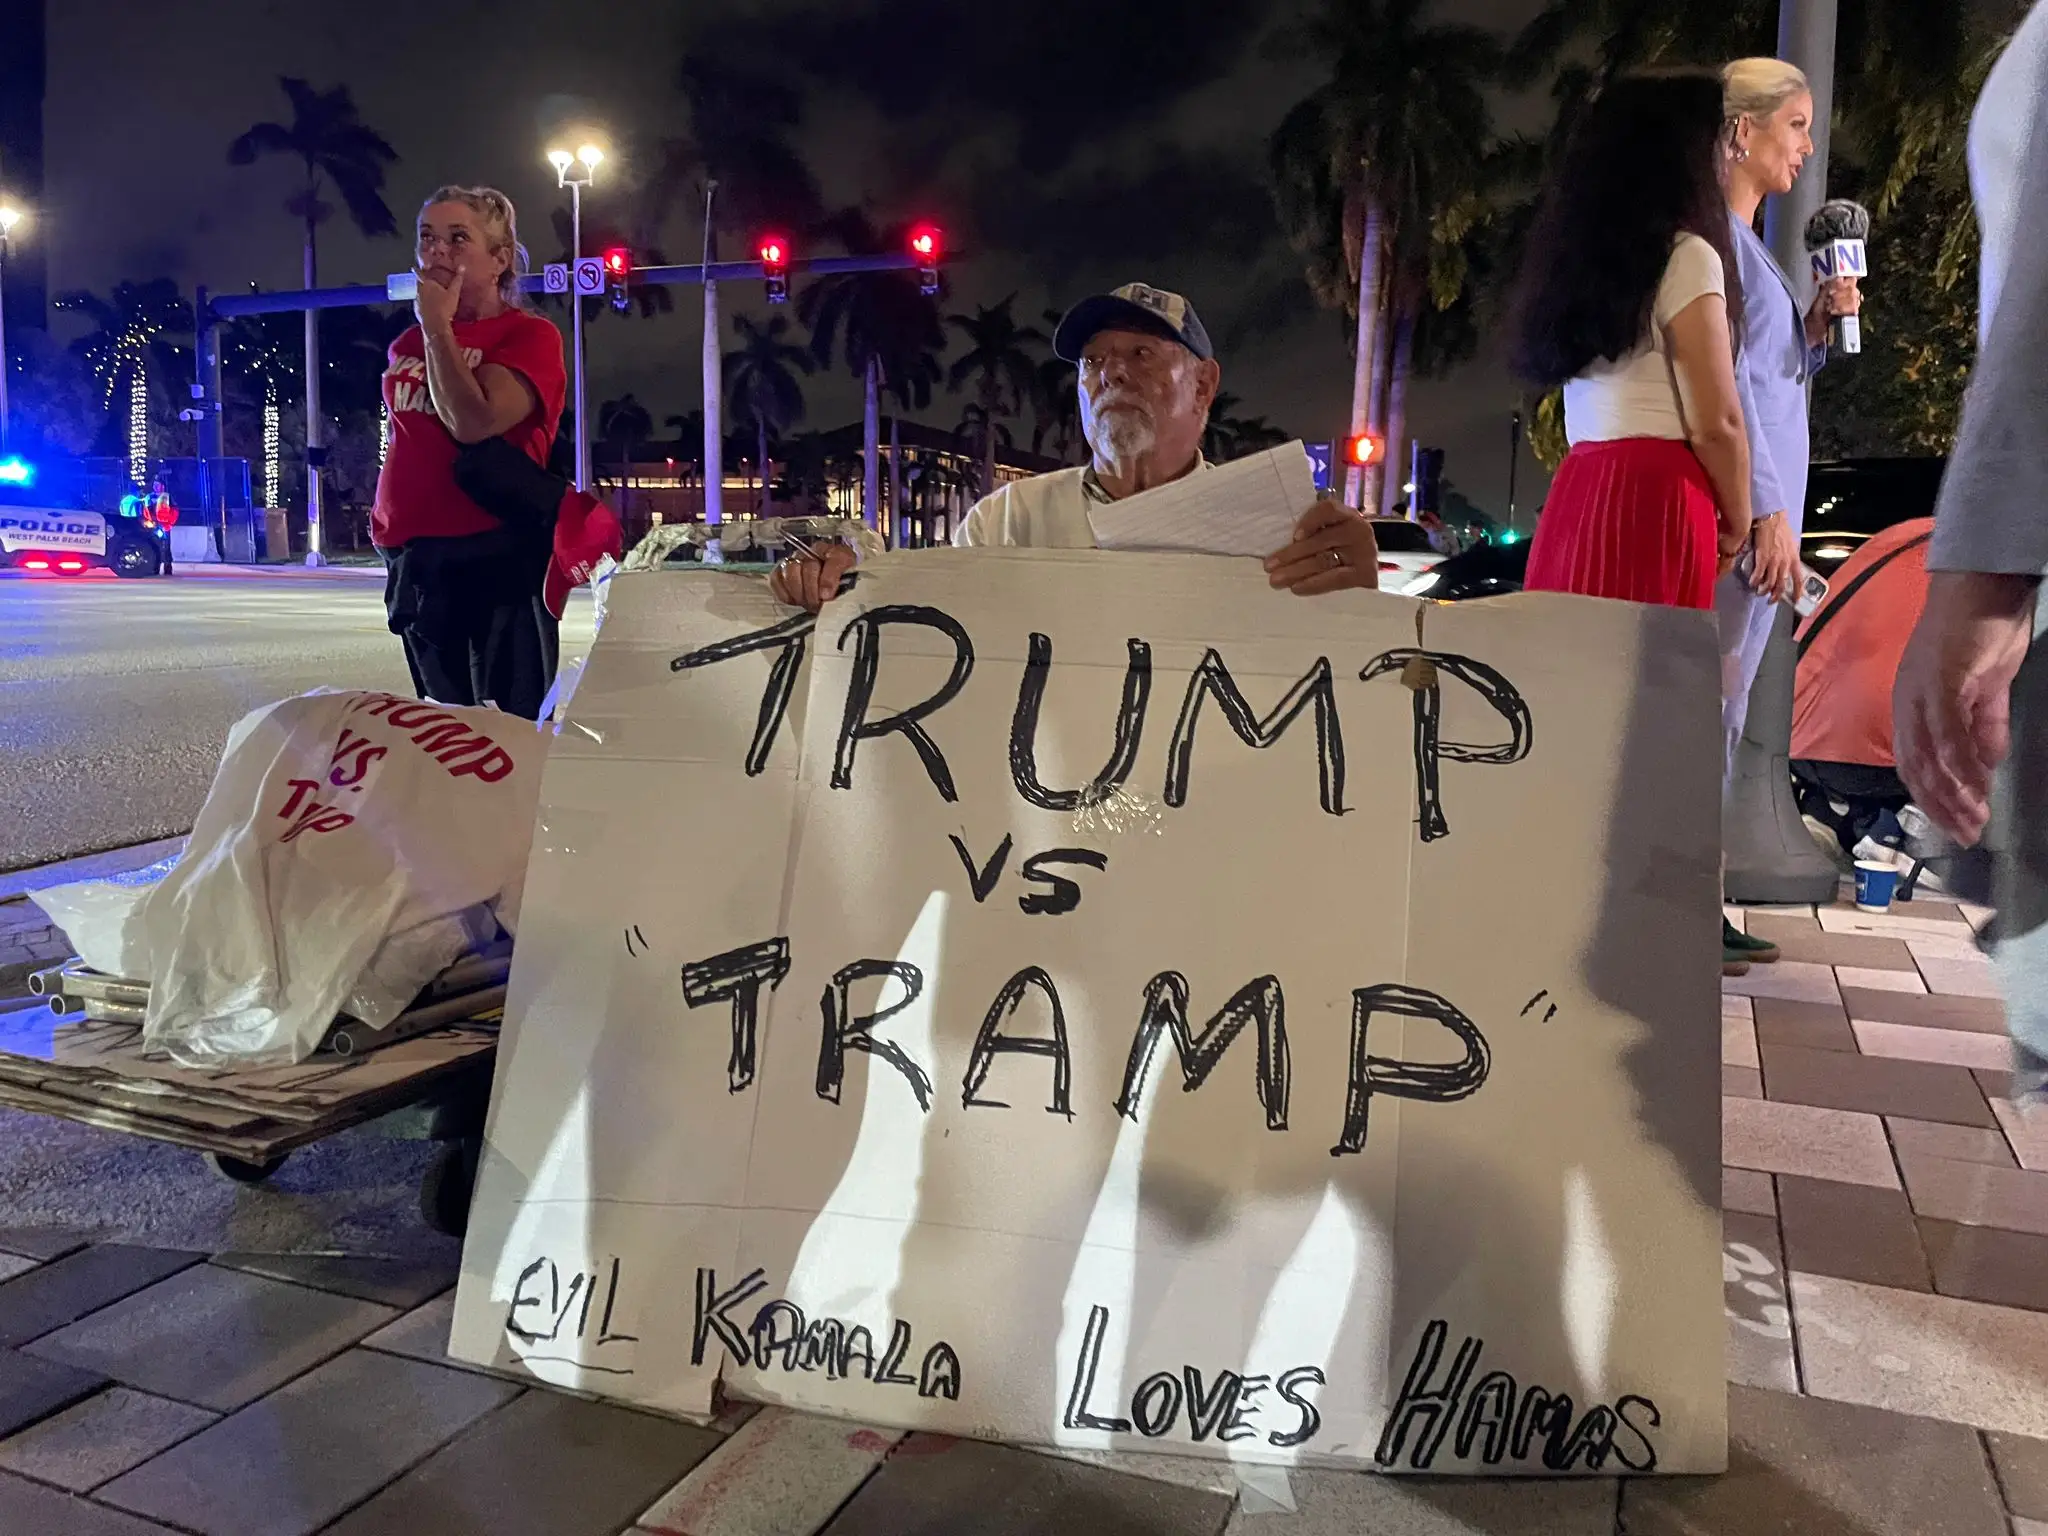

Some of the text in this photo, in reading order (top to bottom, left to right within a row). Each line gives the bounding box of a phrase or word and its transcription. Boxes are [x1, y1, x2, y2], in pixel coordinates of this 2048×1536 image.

[0, 518, 100, 536] POLICE
[9, 533, 91, 545] WEST PALM BEACH
[671, 604, 1533, 842] TRUMP
[948, 832, 1109, 916] VS
[506, 1256, 1662, 1470] EVIL KAMALA LOVES HAMAS
